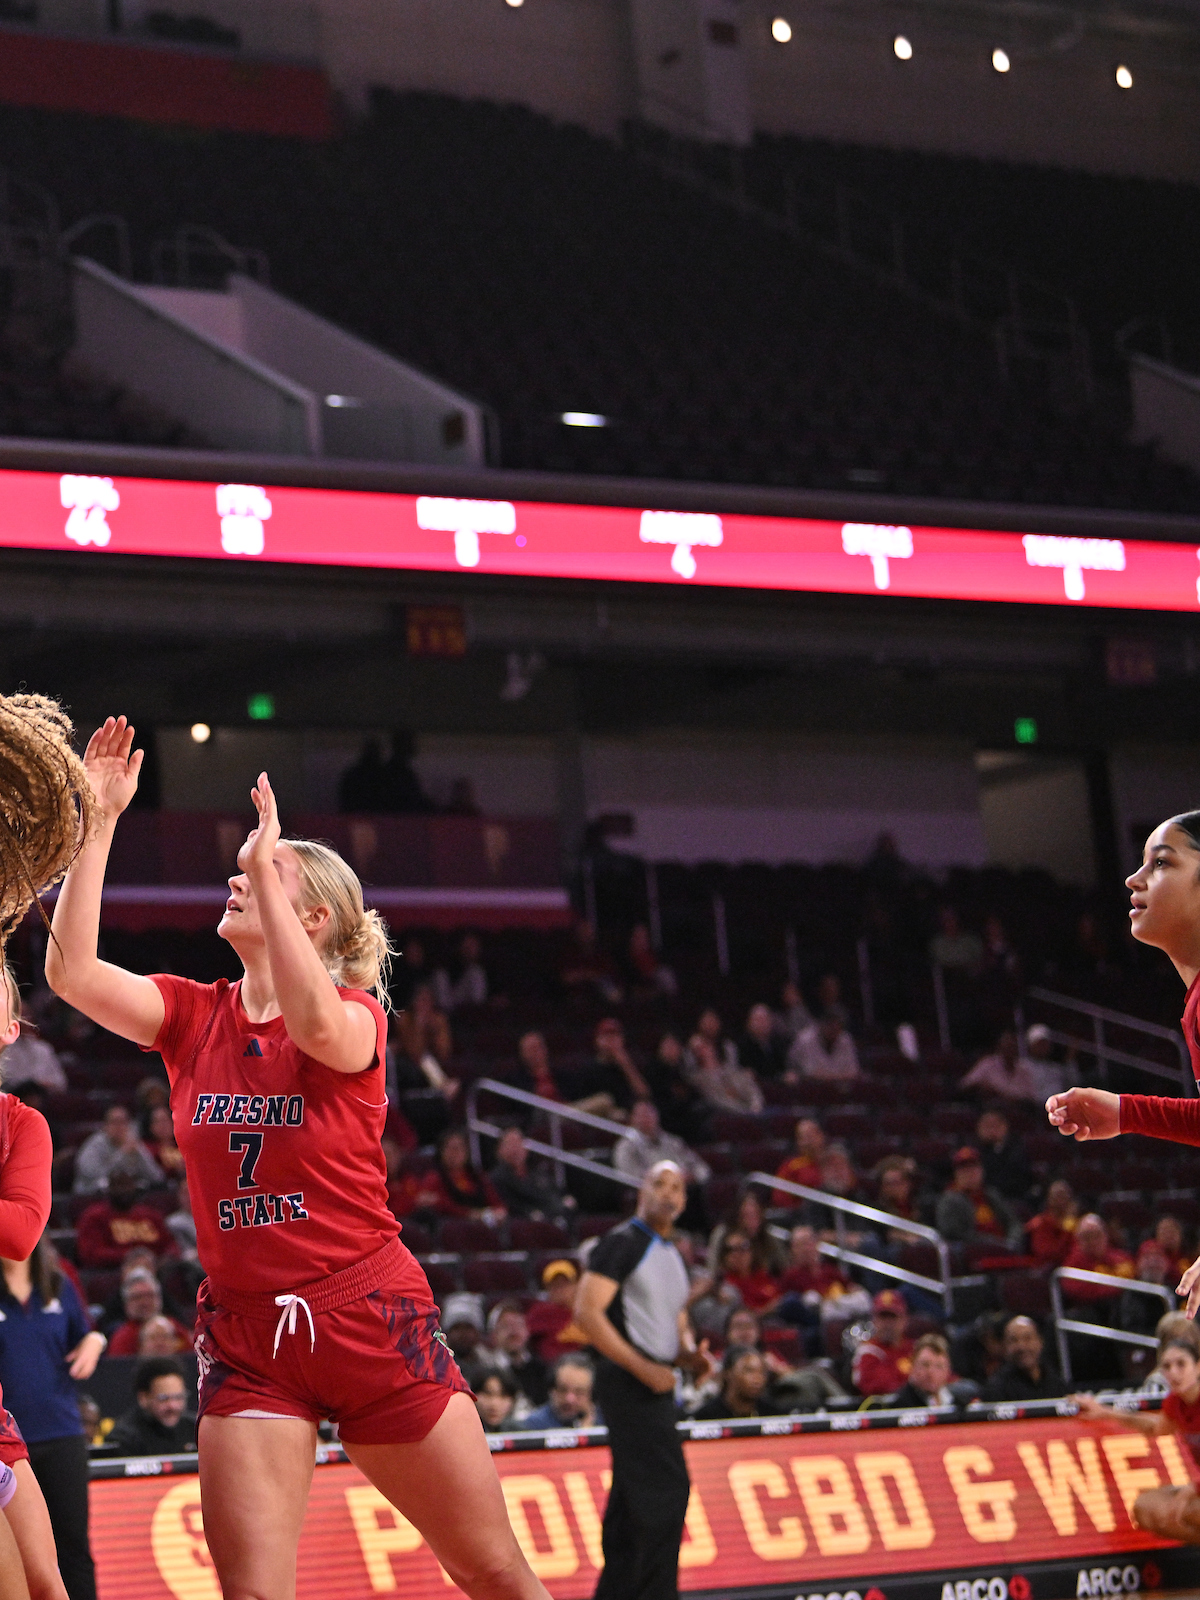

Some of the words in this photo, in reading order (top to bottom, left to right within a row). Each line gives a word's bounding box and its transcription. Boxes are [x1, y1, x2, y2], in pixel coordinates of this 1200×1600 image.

[191, 1093, 305, 1127] FRESNO
[228, 1131, 264, 1190] 7
[218, 1191, 310, 1232] STATE
[728, 1450, 936, 1562] CBD
[943, 1445, 1019, 1543] &
[940, 1576, 1008, 1600] ARCO
[1076, 1564, 1140, 1598] ARCO
